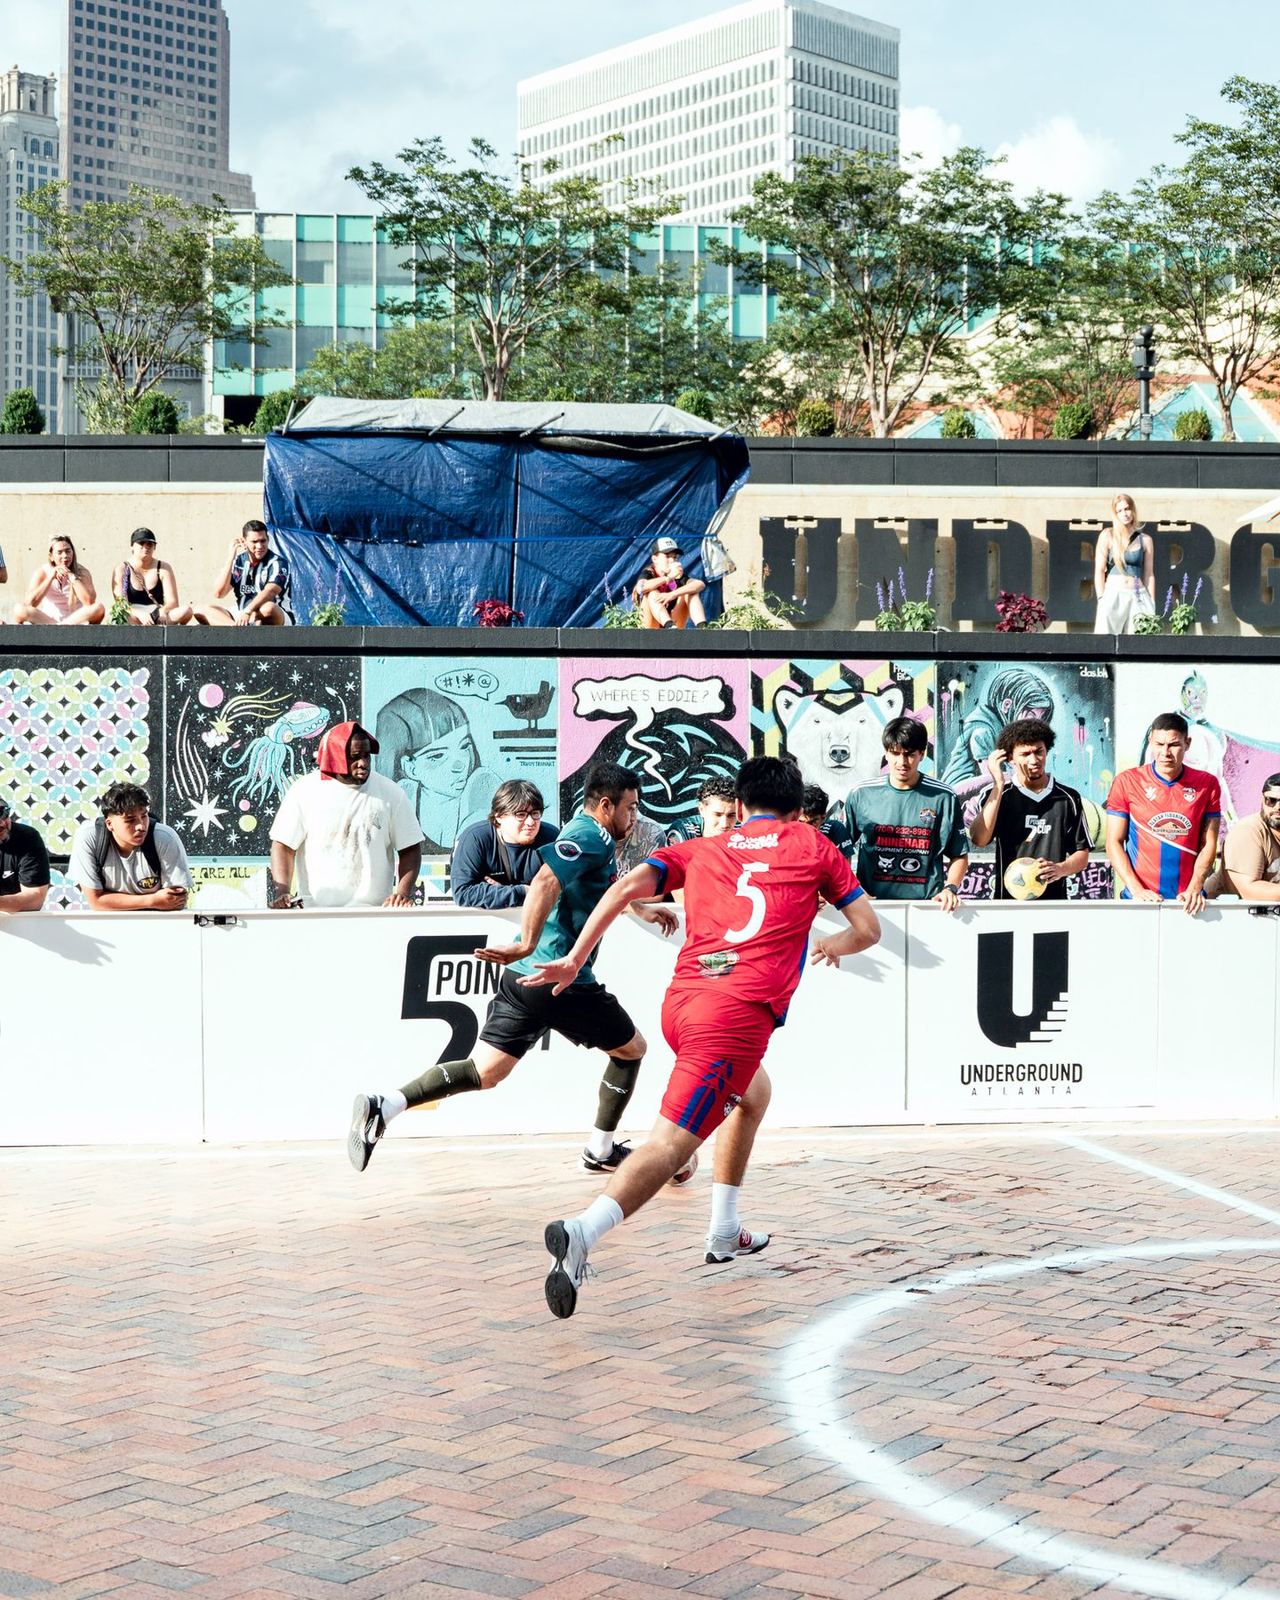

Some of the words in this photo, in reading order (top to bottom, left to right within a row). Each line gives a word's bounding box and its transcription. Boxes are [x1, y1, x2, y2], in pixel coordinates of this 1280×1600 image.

[591, 688, 650, 702] WHERE'S
[657, 689, 710, 703] EDDIE?
[1037, 825, 1052, 835] CUP
[200, 867, 226, 879] ARE
[229, 867, 251, 879] ALL
[723, 862, 770, 943] 5
[435, 960, 501, 996] POIN
[401, 935, 488, 1107] 5
[961, 1063, 1083, 1085] UNDERGROUND
[971, 1086, 1072, 1095] ATLANTA
